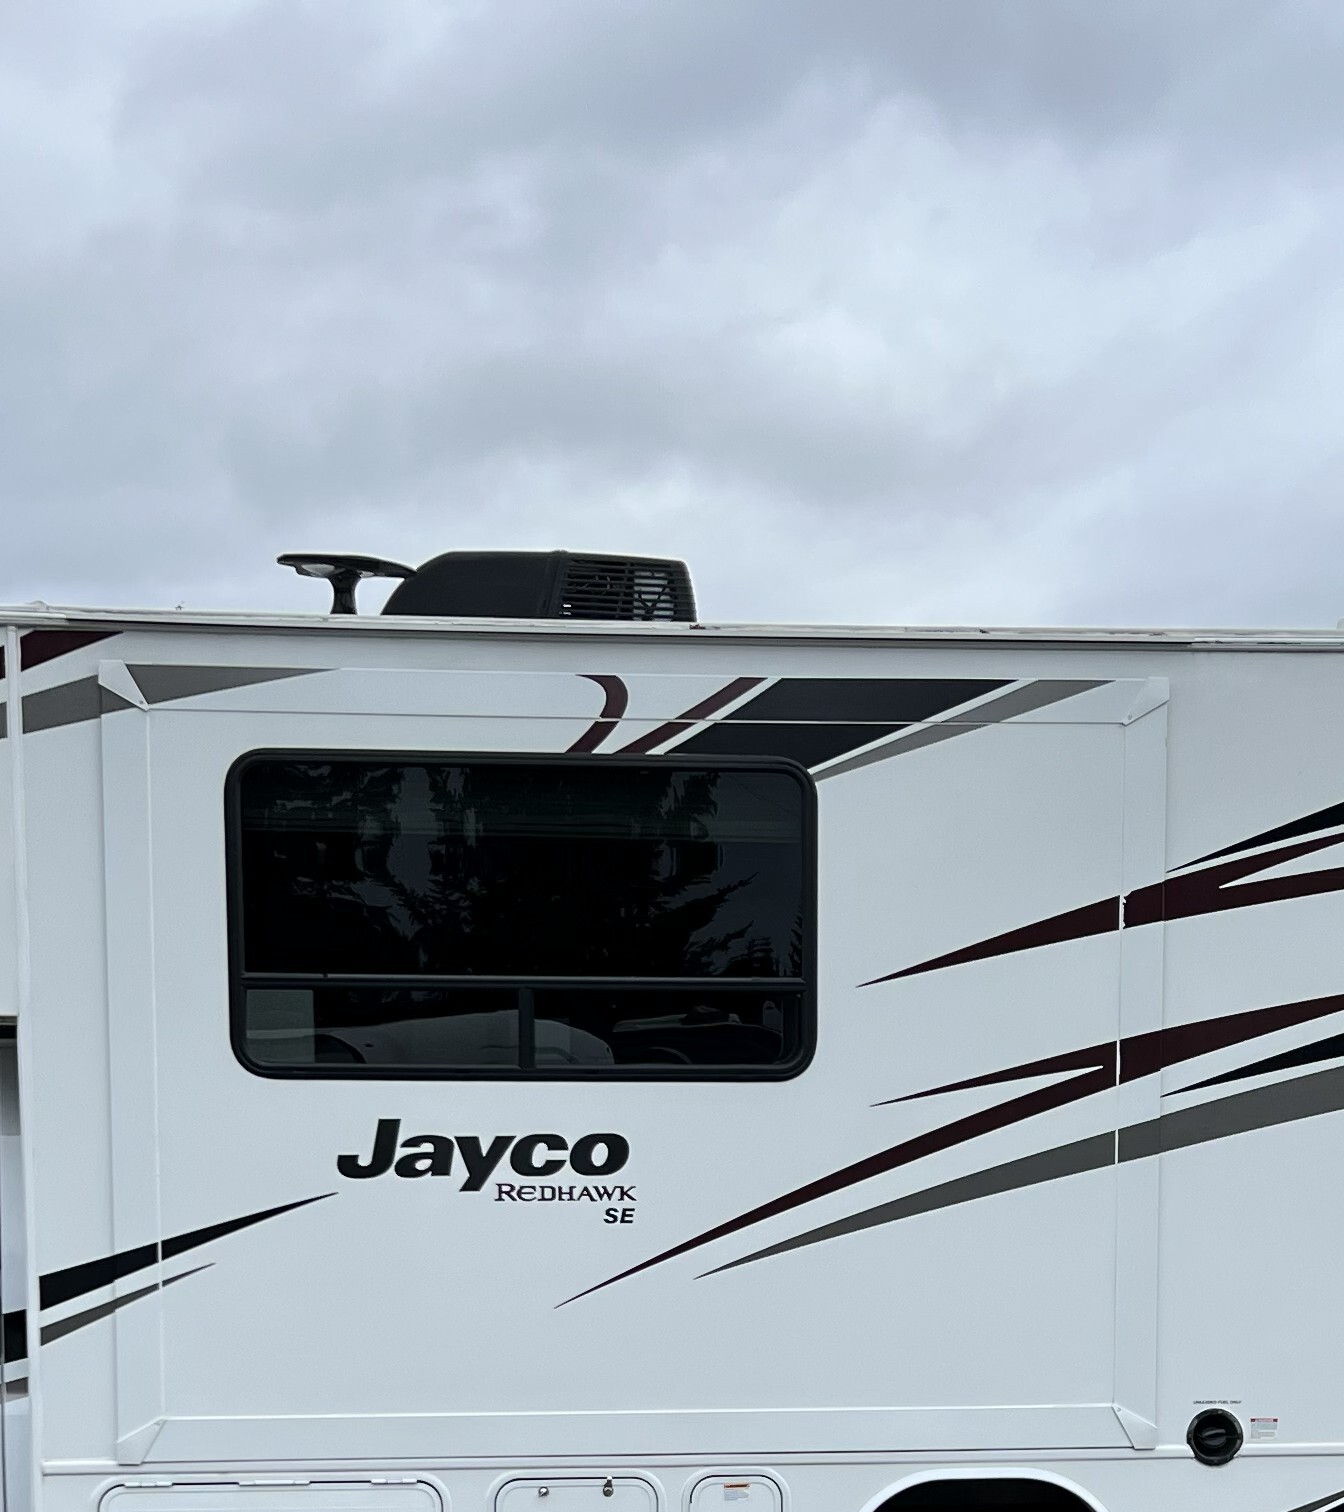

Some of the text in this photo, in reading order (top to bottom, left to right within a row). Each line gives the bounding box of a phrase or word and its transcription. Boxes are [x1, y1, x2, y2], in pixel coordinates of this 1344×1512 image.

[337, 1118, 630, 1192] Jayco
[494, 1183, 637, 1202] REDHAWK
[603, 1207, 636, 1224] SE
